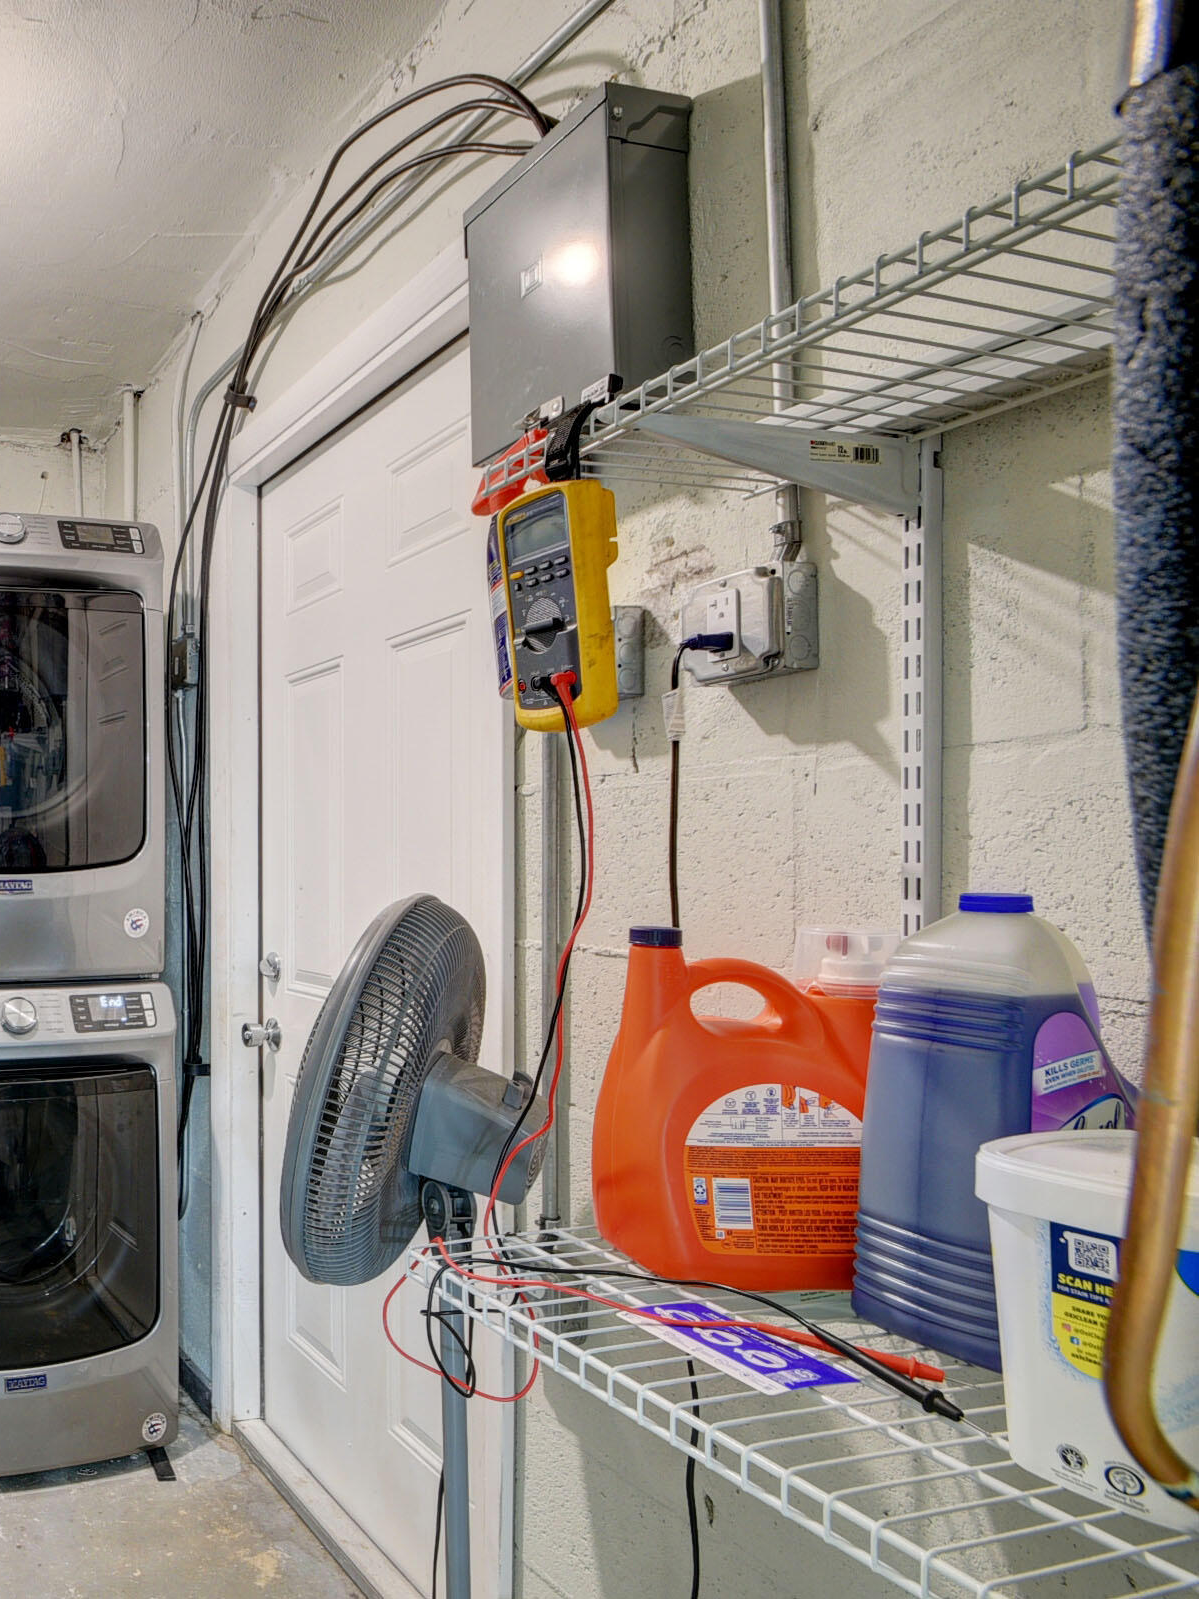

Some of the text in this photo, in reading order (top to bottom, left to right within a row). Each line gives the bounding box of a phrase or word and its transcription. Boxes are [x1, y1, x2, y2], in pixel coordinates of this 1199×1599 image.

[100, 995, 123, 1007] End
[1044, 1055, 1094, 1077] KILLS GERMS
[1057, 1272, 1114, 1297] SCAN HE
[1072, 1306, 1095, 1317] SHARE
[7, 1375, 47, 1390] MAYTAG
